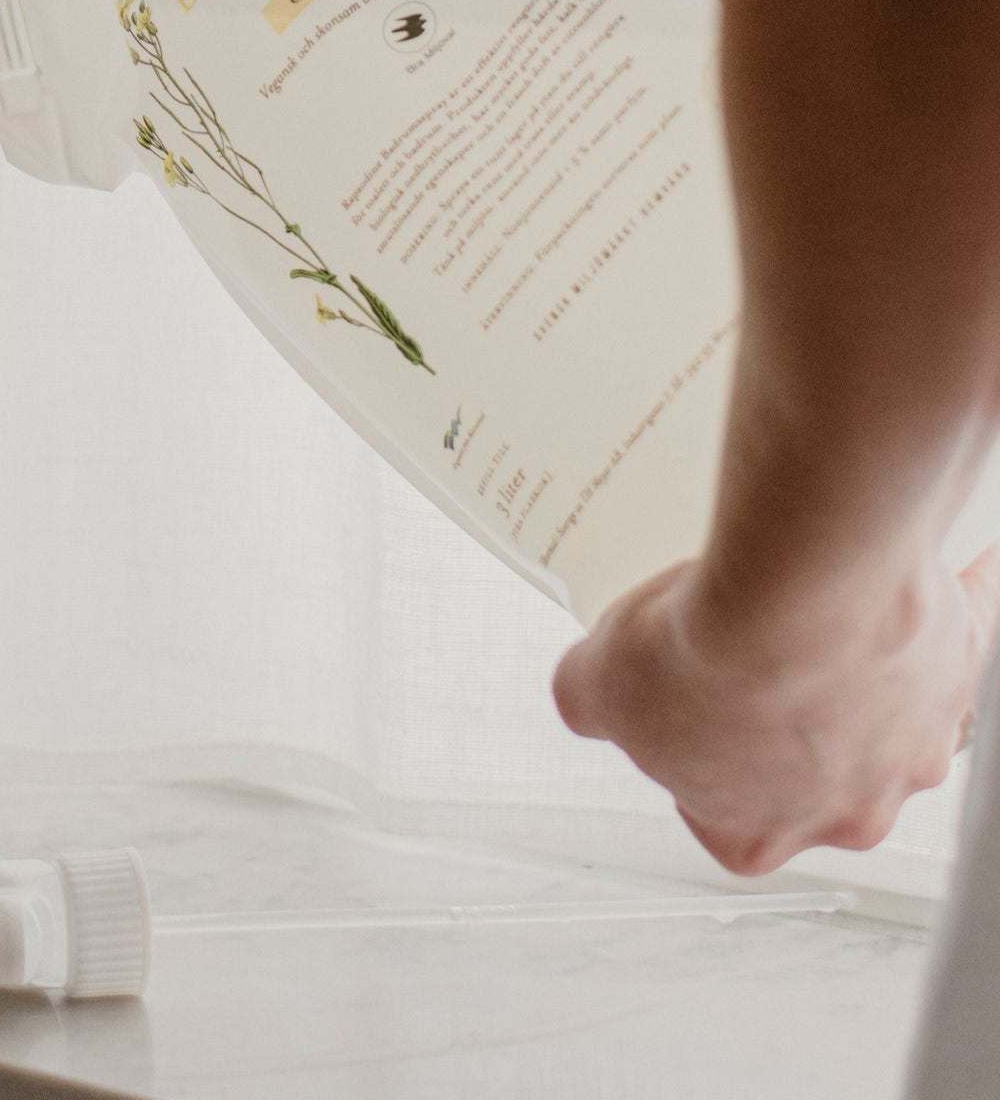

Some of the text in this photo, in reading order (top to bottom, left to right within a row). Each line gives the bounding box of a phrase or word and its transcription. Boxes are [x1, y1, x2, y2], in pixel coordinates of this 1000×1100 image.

[259, 56, 298, 100] Vegansk
[299, 36, 315, 60] och
[314, 0, 361, 40] skonsam
[497, 467, 527, 505] liter
